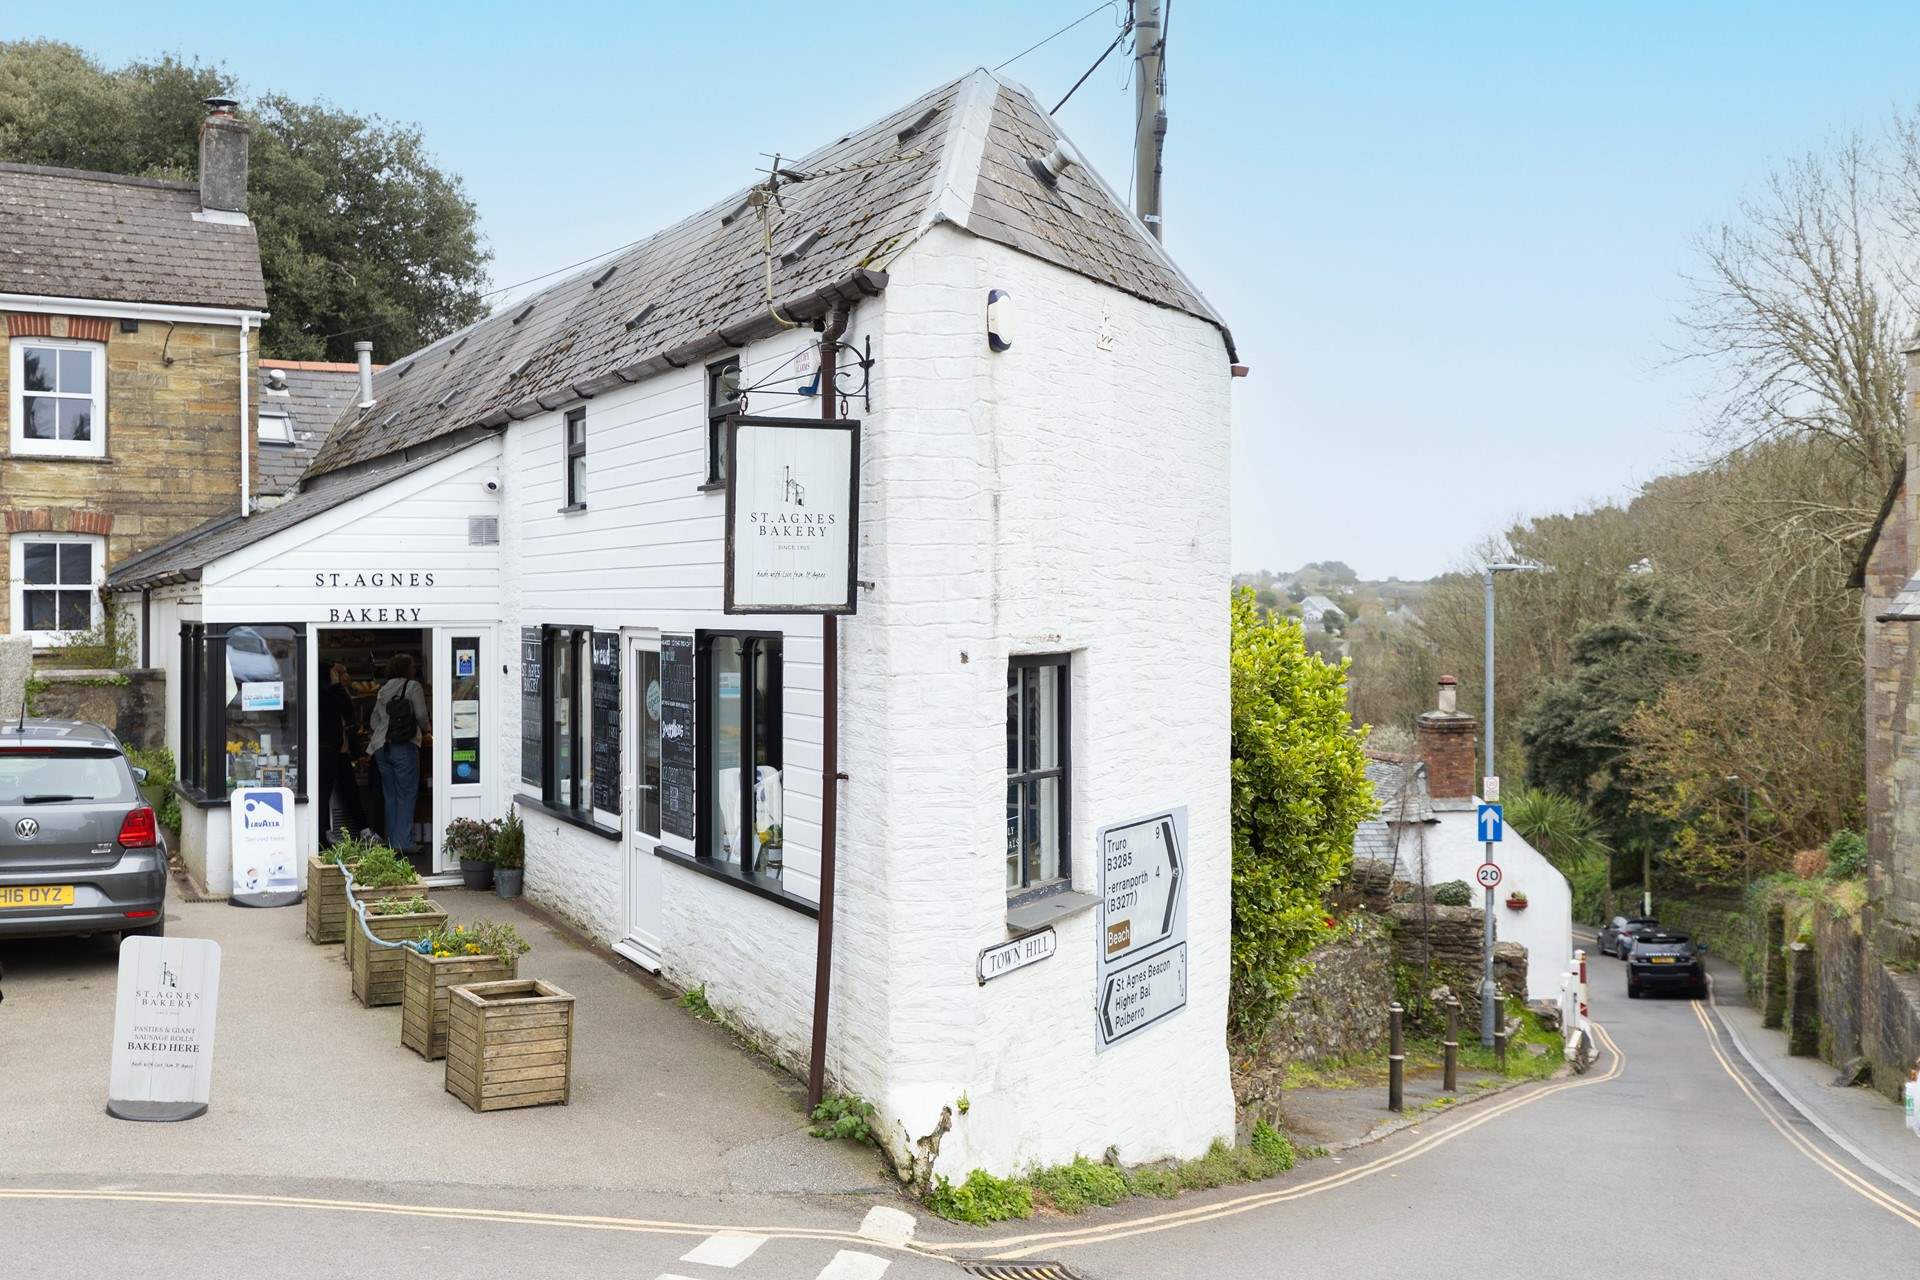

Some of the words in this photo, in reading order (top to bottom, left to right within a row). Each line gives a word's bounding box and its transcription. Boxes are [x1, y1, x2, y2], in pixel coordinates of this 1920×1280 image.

[759, 525, 826, 537] BAKERY
[330, 608, 421, 622] BAKERY
[1107, 839, 1127, 853] Truro
[1155, 826, 1160, 839] 9
[1107, 852, 1133, 872] B3285
[1155, 866, 1160, 878] 4
[1481, 870, 1499, 880] 20
[29, 888, 62, 902] OYZ
[1106, 890, 1138, 915] (B3277)
[1108, 926, 1131, 946] Beach
[990, 947, 1021, 972] TOWN
[1026, 936, 1049, 958] HILL
[1116, 977, 1124, 992] St
[1126, 971, 1147, 989] Agnes
[1148, 960, 1171, 978] Beacon
[142, 999, 193, 1008] BAKERY
[1115, 992, 1137, 1011] Higher
[1139, 983, 1151, 999] Bal
[1115, 1007, 1145, 1029] Polberro
[164, 1026, 170, 1034] &
[127, 1041, 167, 1051] BAKED
[169, 1043, 200, 1053] HERE
